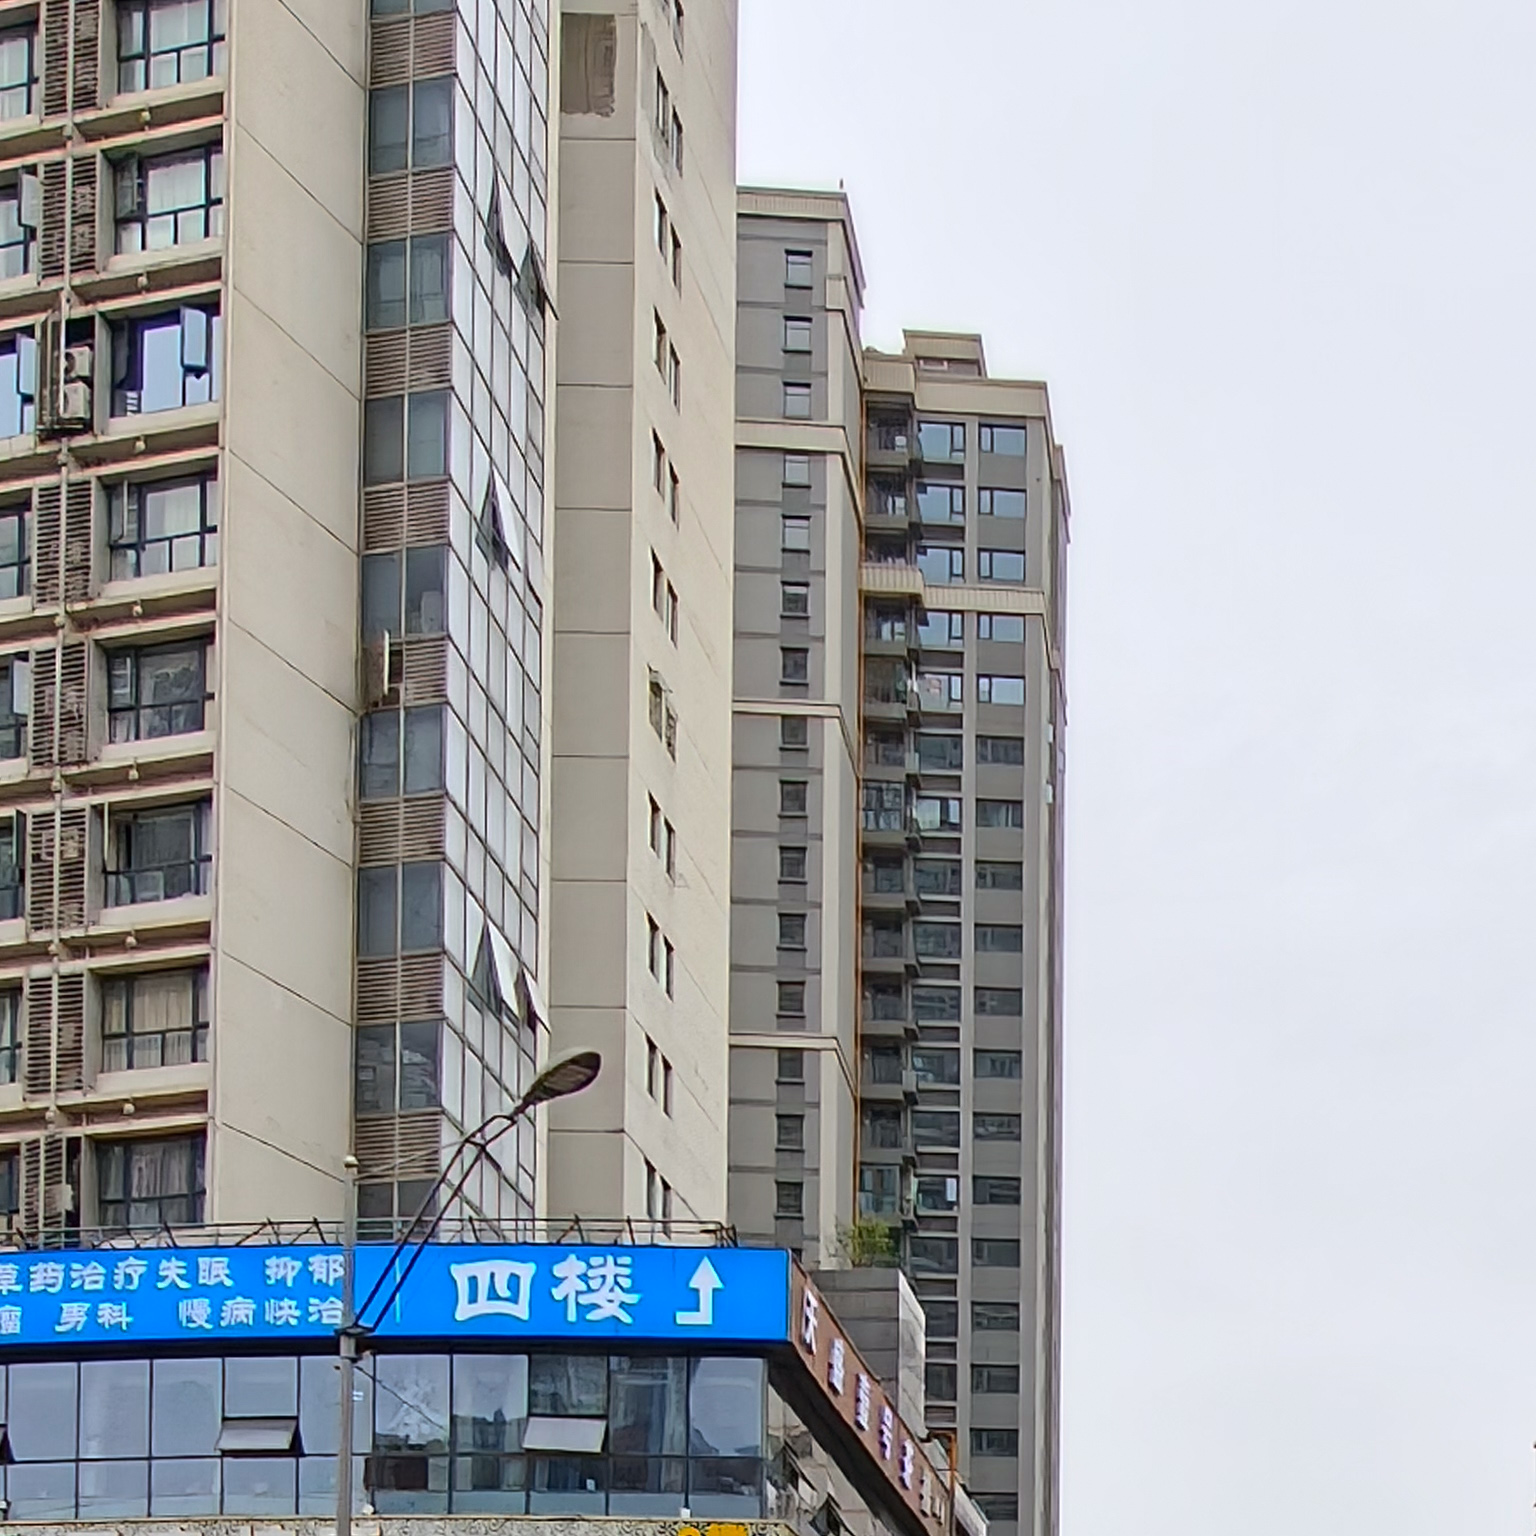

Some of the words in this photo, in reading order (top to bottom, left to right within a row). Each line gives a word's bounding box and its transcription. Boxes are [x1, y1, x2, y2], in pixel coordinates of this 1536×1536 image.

[264, 1254, 344, 1287] 抑郁
[450, 1255, 642, 1325] 四楼
[55, 1302, 133, 1333] 男科
[178, 1296, 343, 1330] 慢病快治
